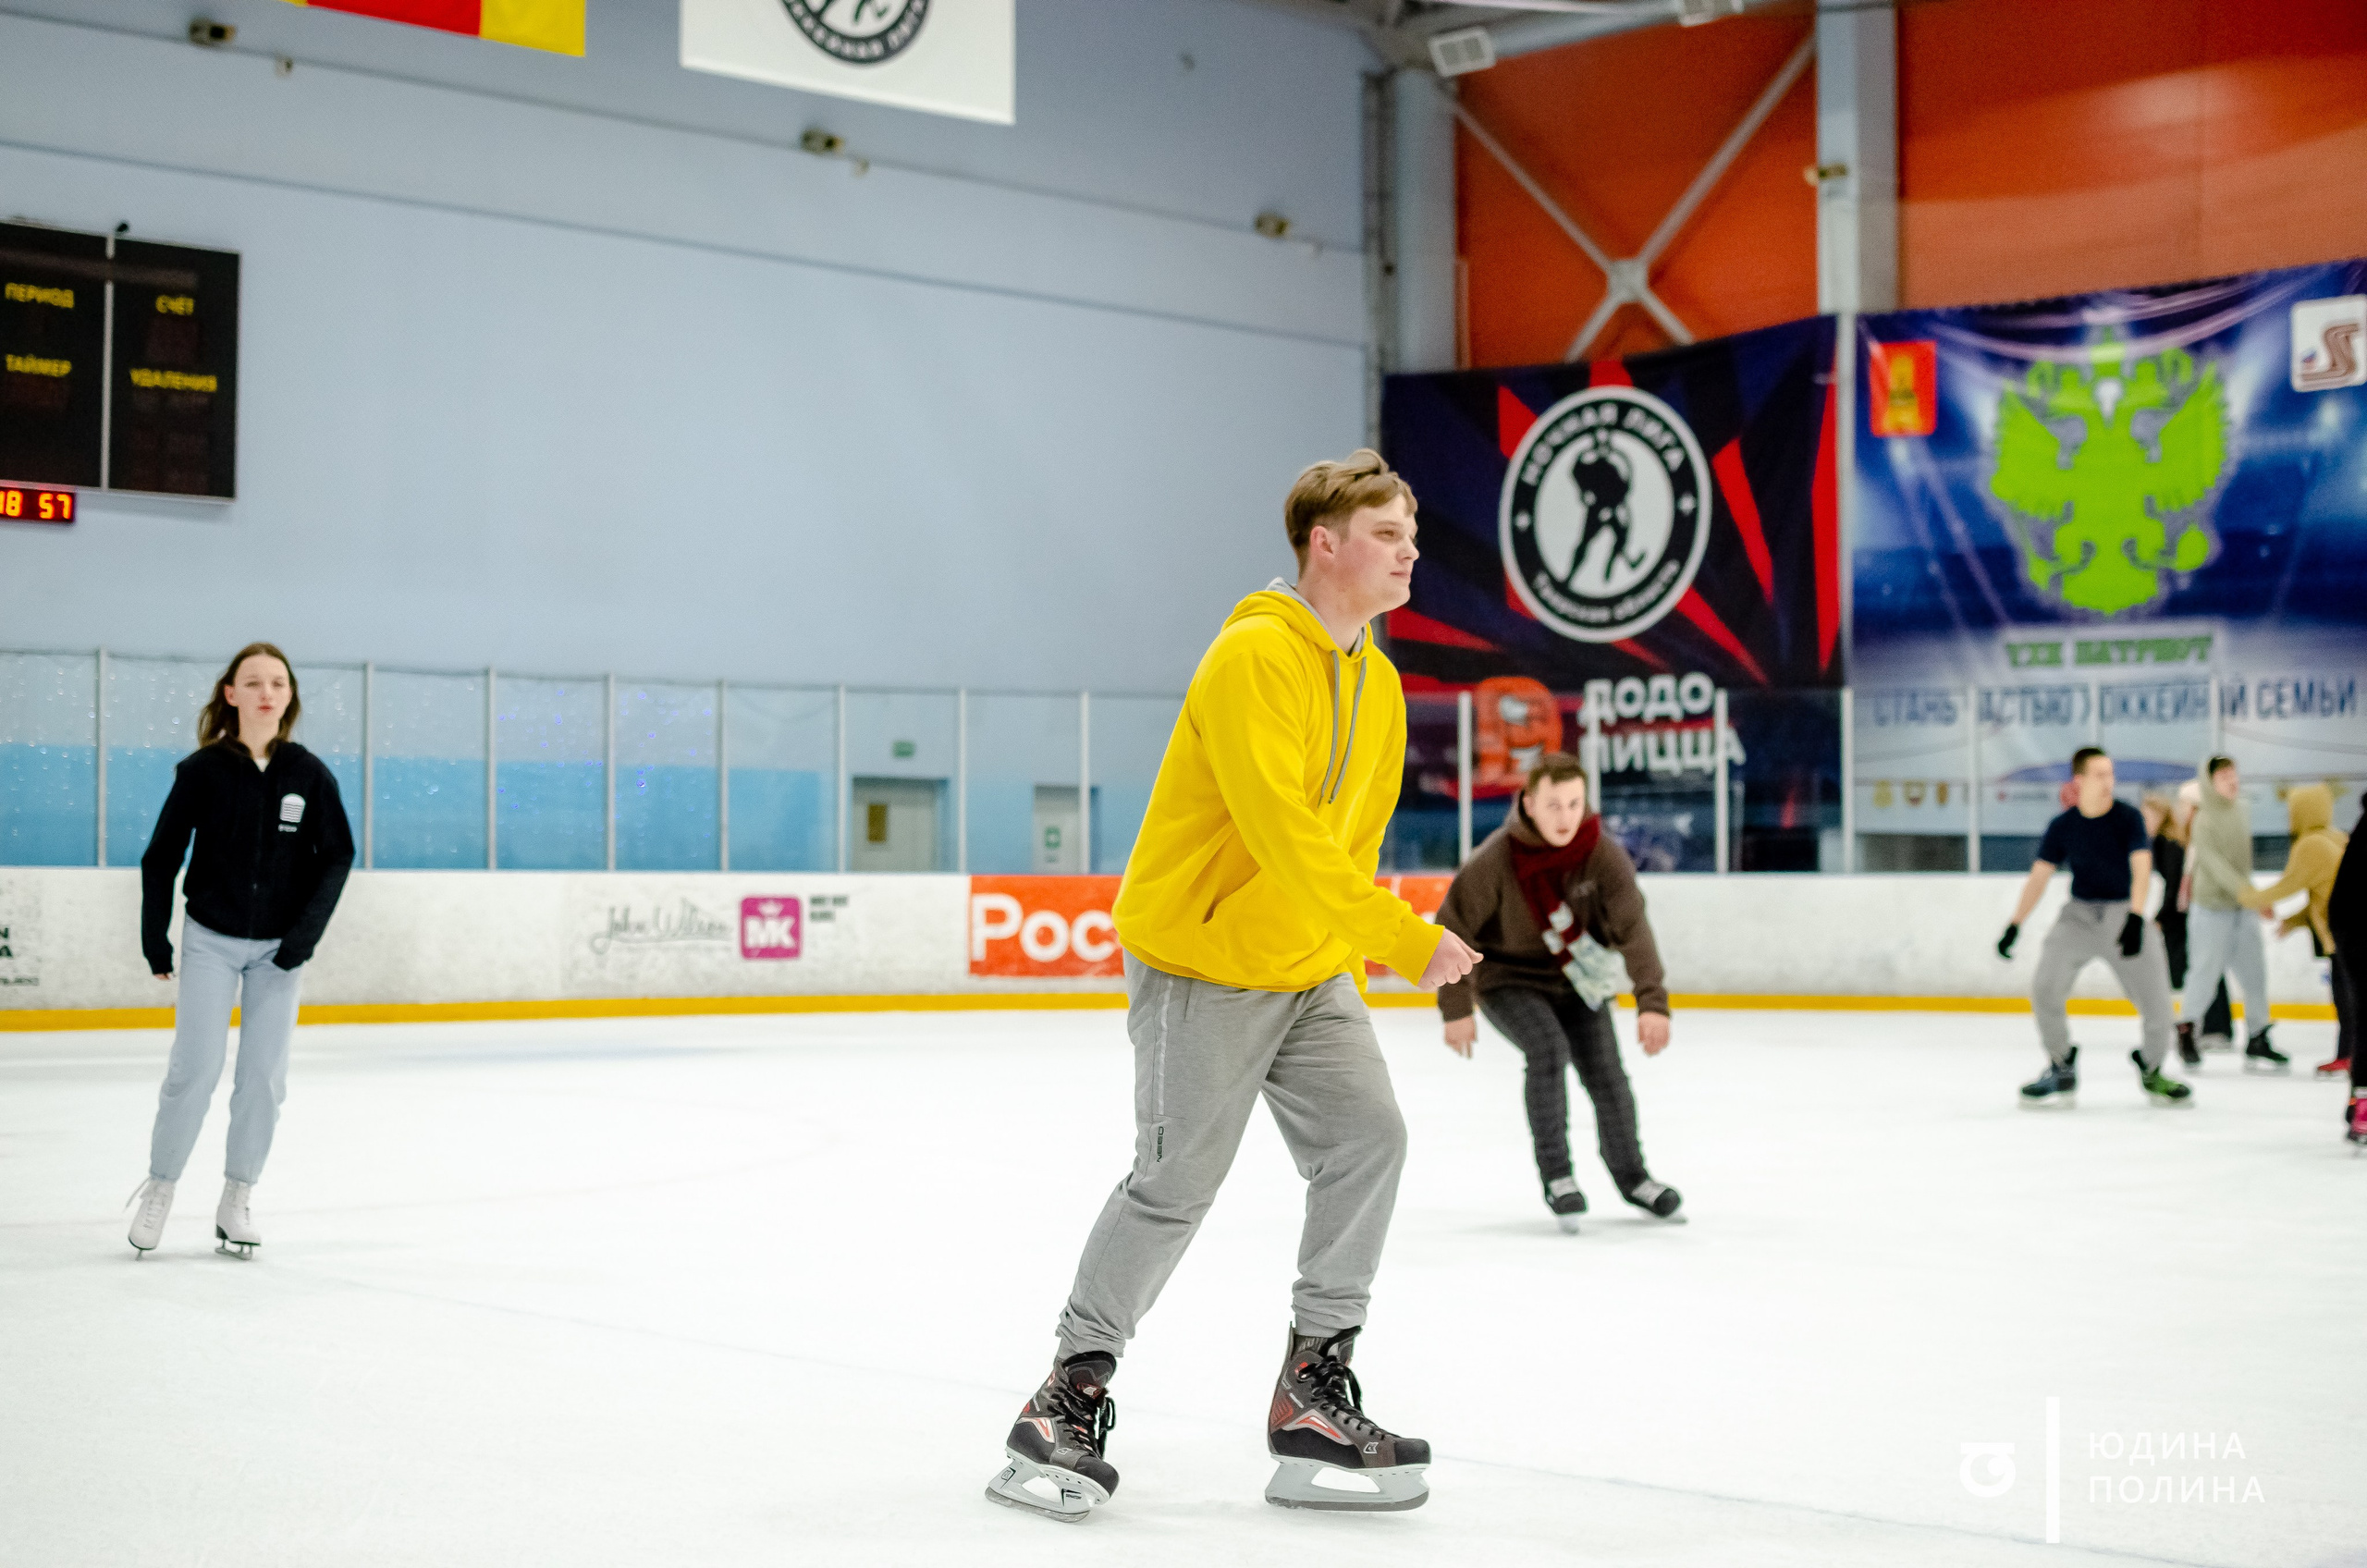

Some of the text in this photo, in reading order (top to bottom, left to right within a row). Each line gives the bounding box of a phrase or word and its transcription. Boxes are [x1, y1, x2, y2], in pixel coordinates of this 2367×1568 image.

[5, 282, 74, 308] ПЕРИОД
[6, 354, 72, 377] ТАЙМЕР
[39, 492, 73, 520] 57
[1577, 672, 1713, 726] ДОДО
[1977, 683, 2073, 726] АСТЬЮ
[972, 892, 1117, 962] Рос
